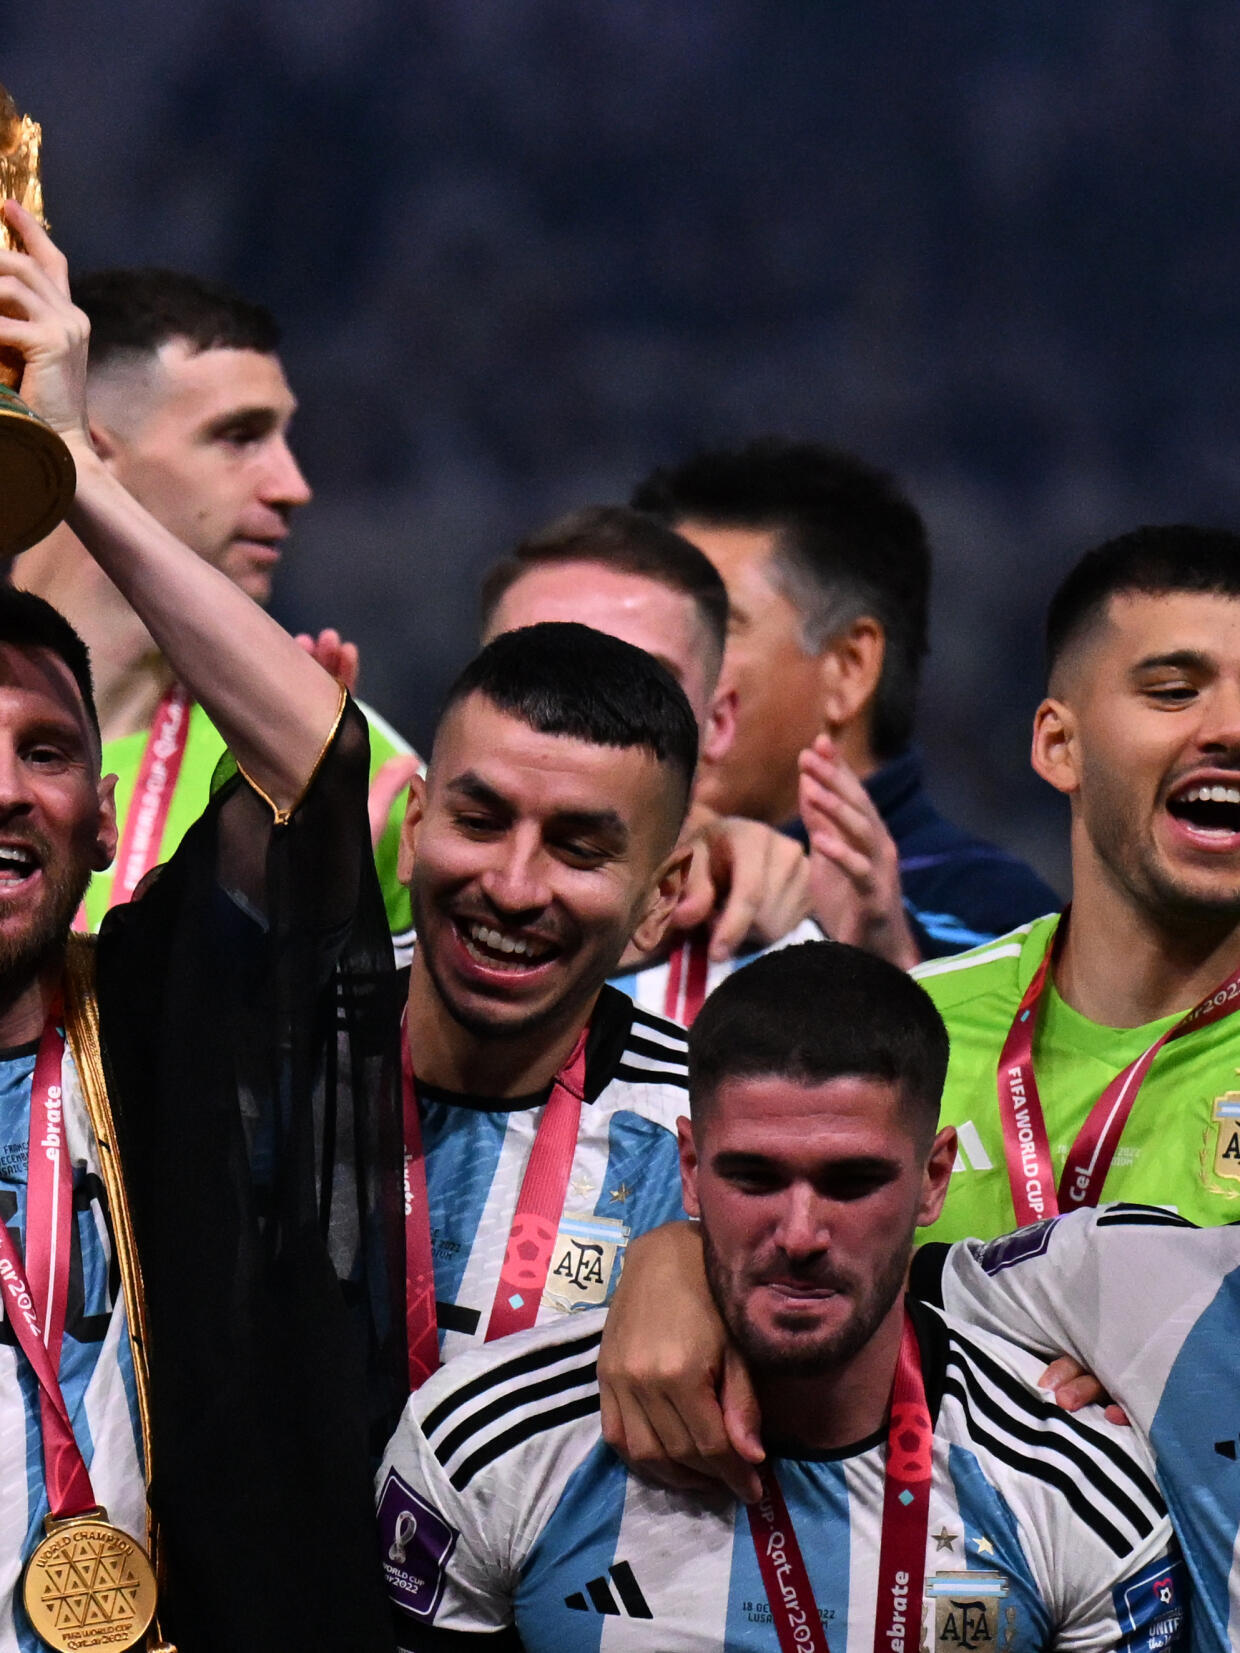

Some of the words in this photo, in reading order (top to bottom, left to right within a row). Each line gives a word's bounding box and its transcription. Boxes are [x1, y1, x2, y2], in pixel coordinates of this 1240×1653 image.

[1008, 1066, 1027, 1110] FIFA
[1015, 1107, 1039, 1178] WORLD
[1025, 1177, 1045, 1214] CUP
[553, 1238, 604, 1290] AFA
[36, 1536, 72, 1569] WORLD
[73, 1531, 135, 1558] CHAMPION
[939, 1600, 993, 1649] AFA
